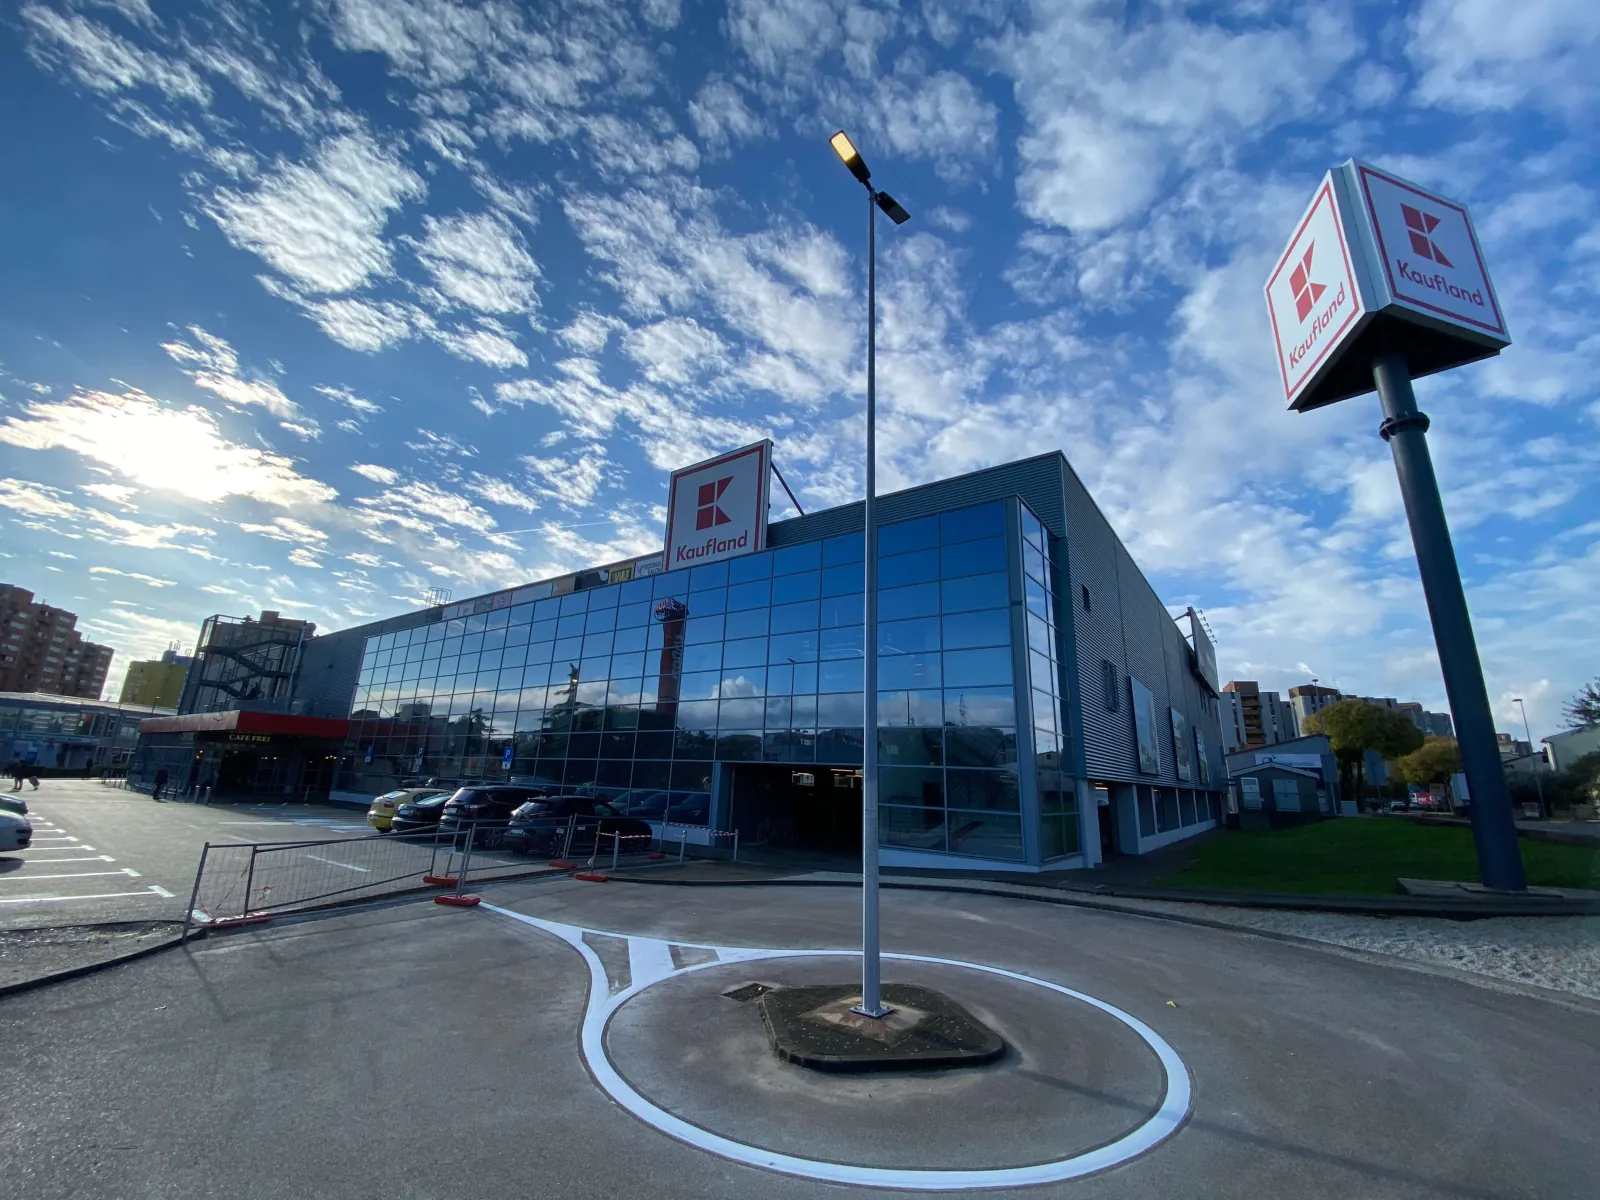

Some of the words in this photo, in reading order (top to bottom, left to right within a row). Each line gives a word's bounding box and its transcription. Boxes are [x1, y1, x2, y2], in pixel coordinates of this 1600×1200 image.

[1396, 259, 1485, 307] Kaufland
[1289, 281, 1346, 369] Kaufland
[676, 529, 748, 562] Kaufland
